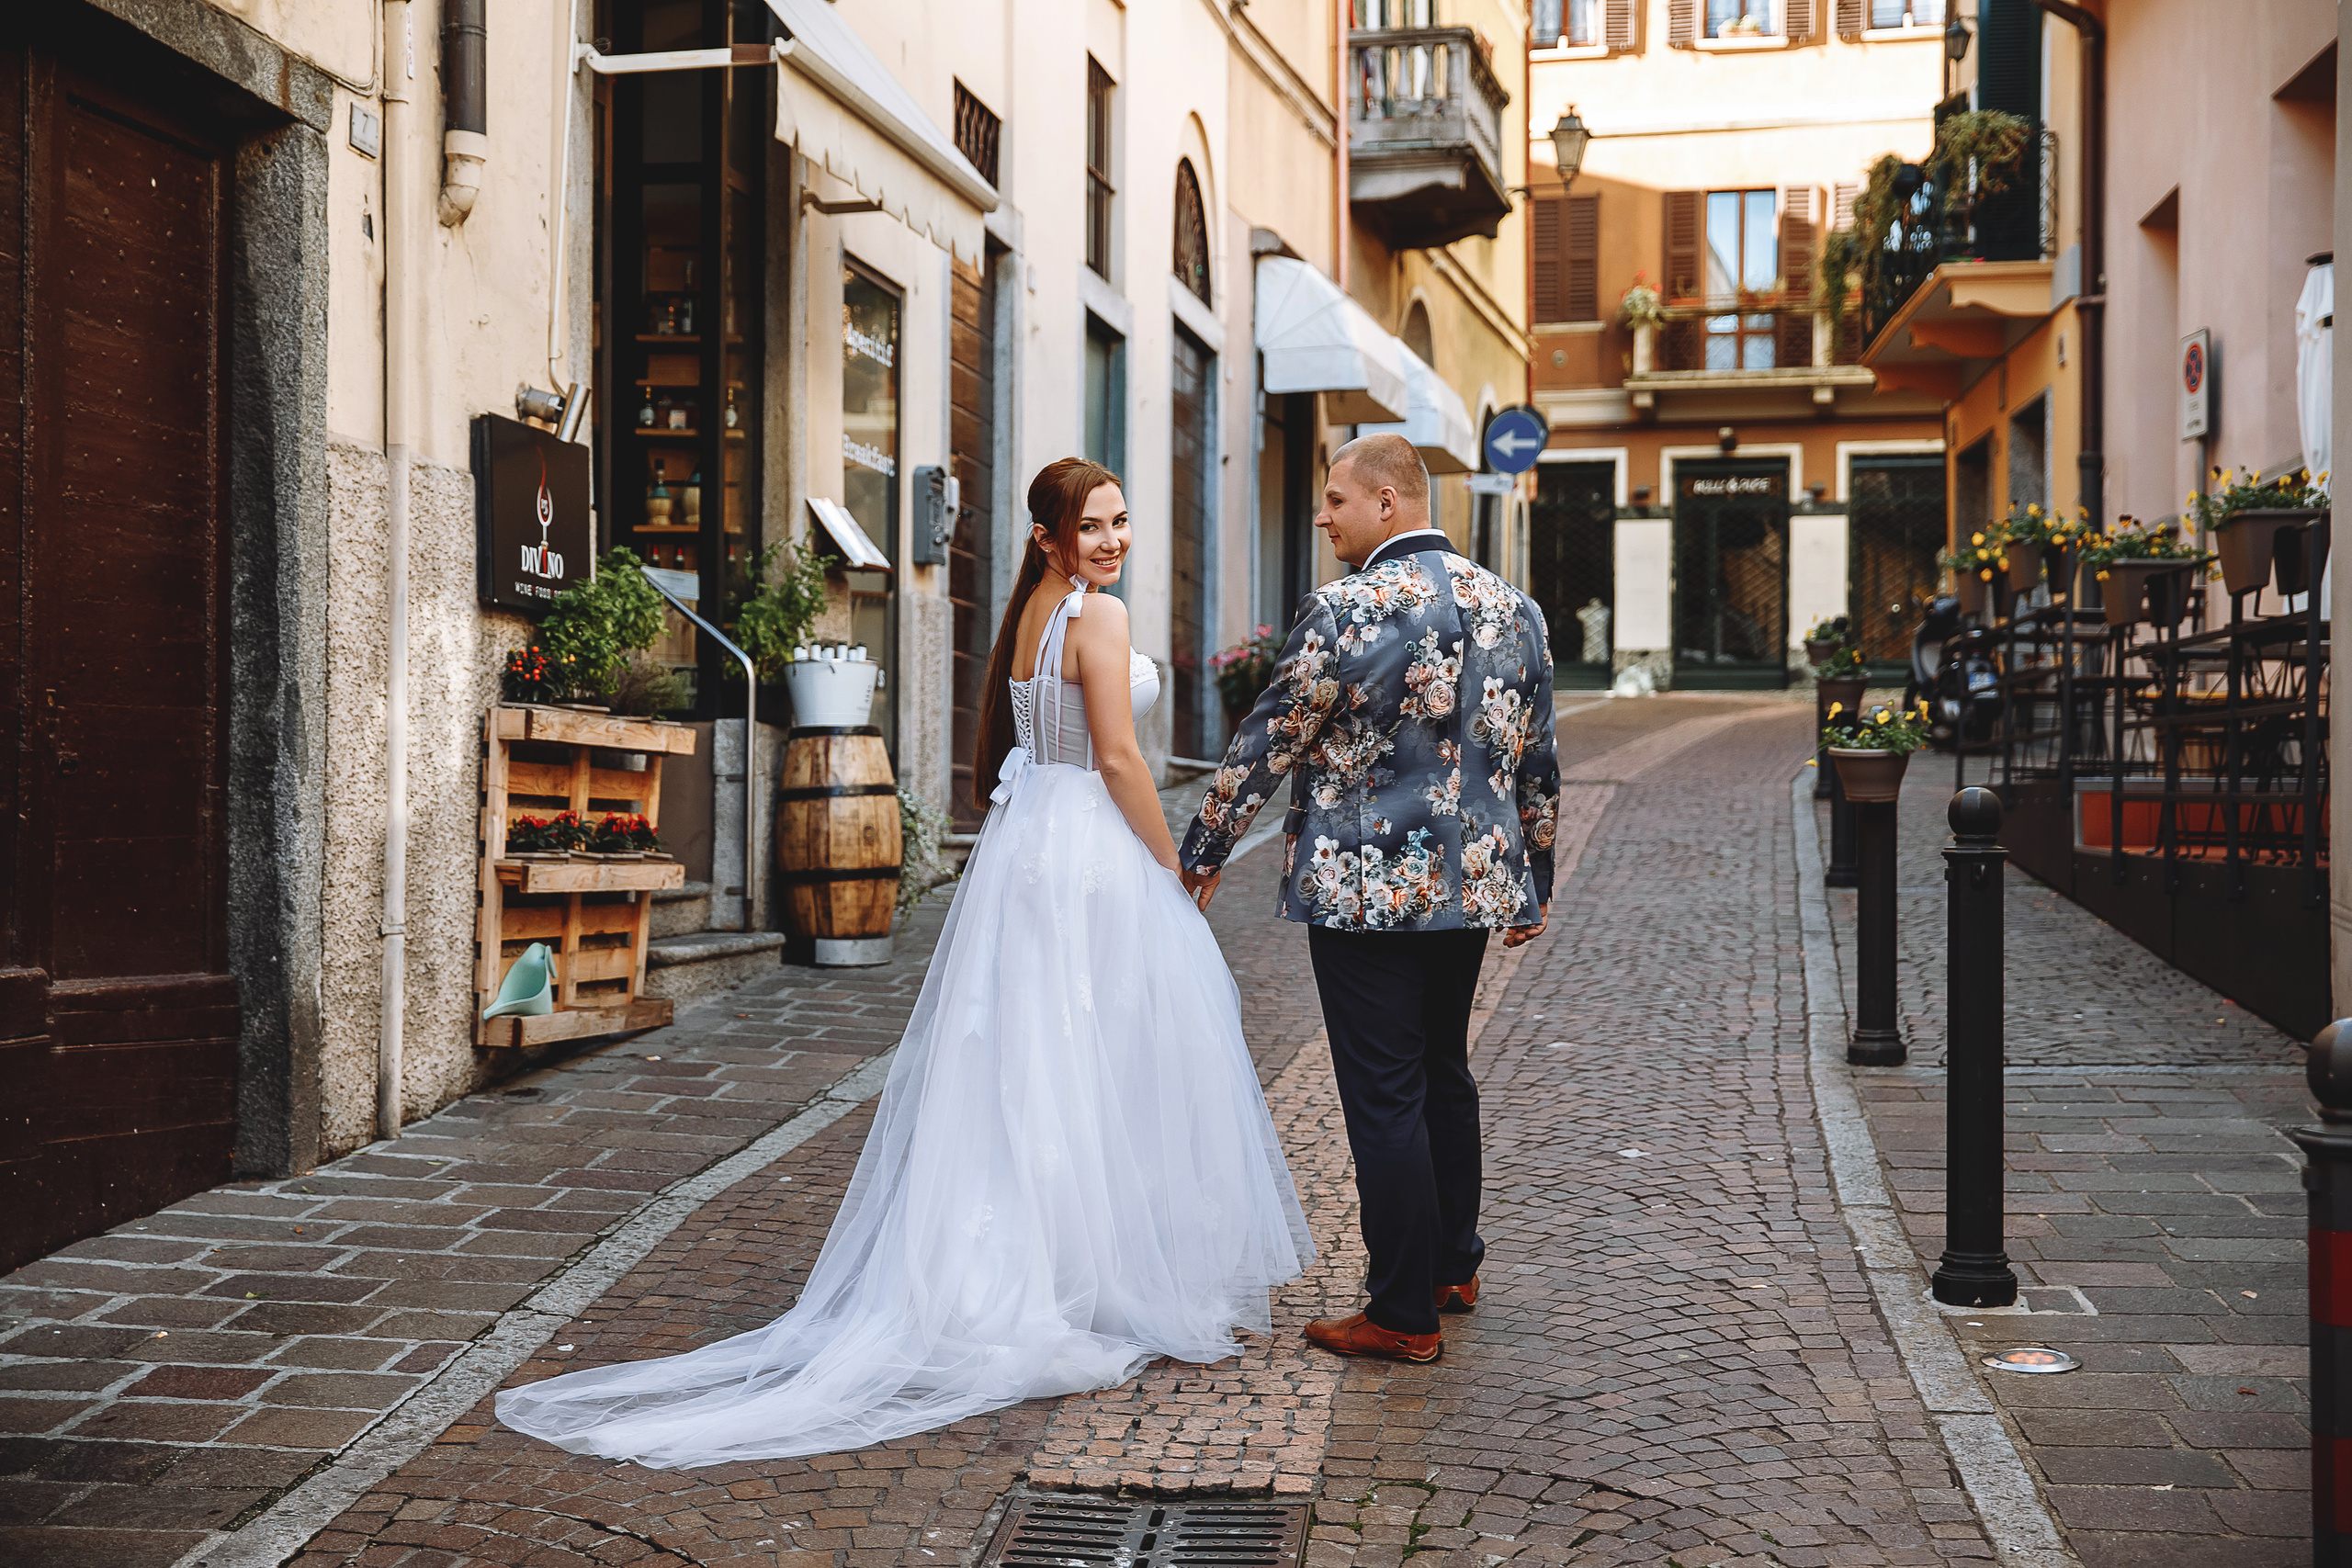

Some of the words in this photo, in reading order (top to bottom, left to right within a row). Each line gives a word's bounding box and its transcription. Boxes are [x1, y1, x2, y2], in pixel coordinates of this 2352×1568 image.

[362, 112, 369, 133] 7
[521, 545, 564, 580] DIVINO
[514, 581, 533, 597] WINE
[535, 585, 551, 600] FOOD
